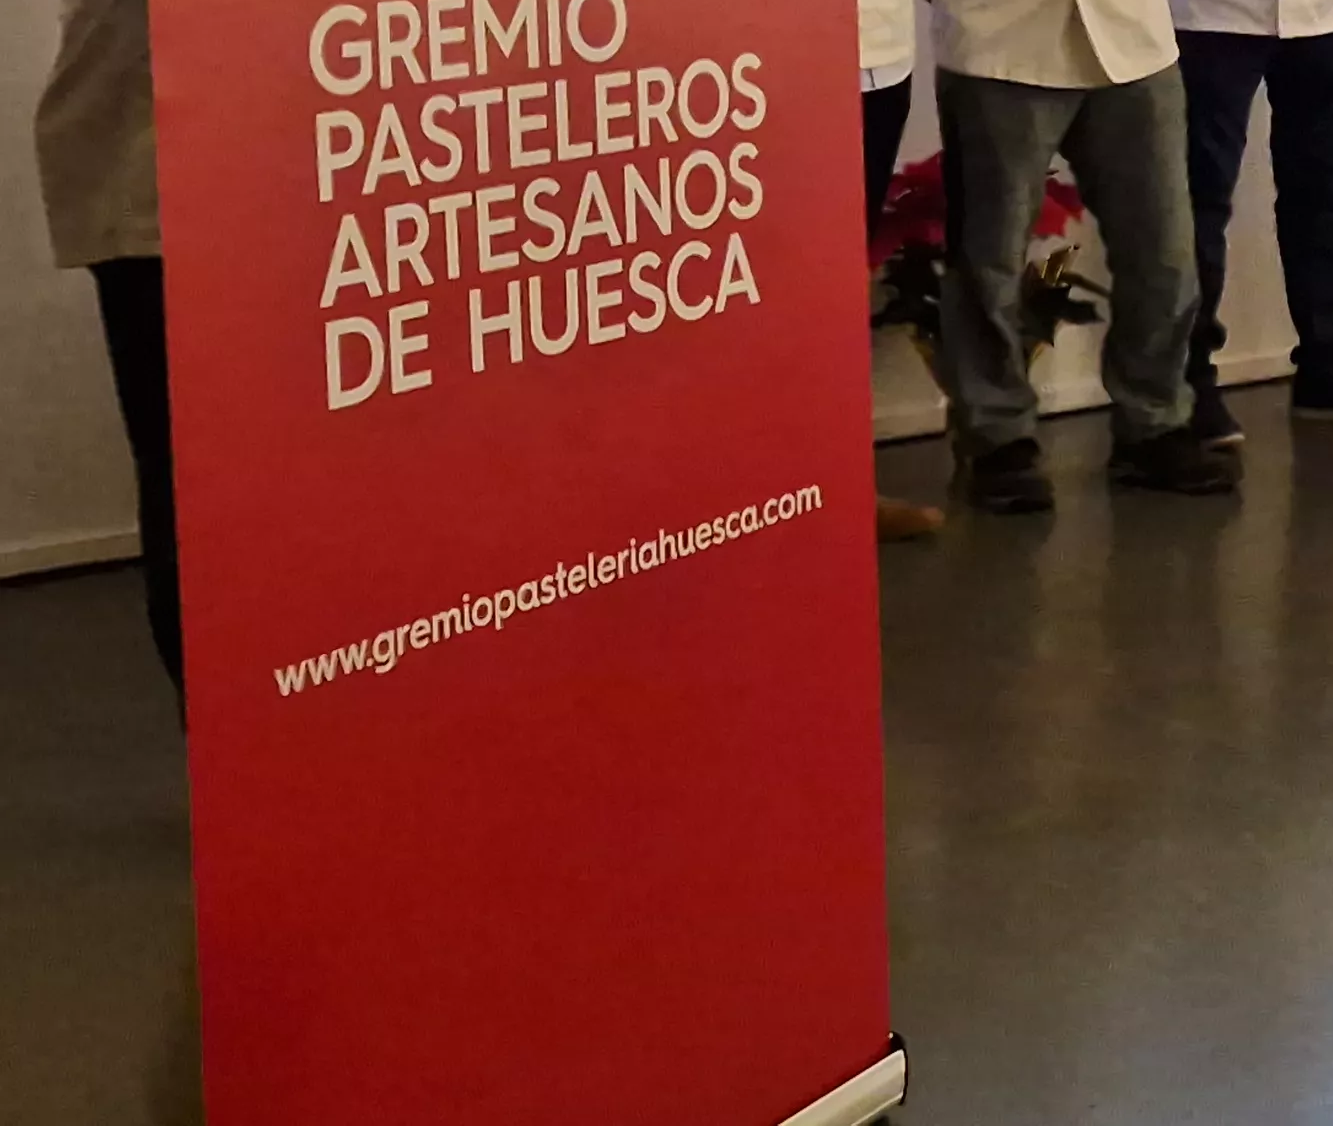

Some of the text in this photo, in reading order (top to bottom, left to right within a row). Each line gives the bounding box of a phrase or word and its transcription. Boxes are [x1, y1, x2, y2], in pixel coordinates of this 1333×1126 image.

[316, 52, 767, 202] PASTELEROS
[320, 142, 764, 308] ARTESANOS
[325, 232, 762, 411] DE HUESCA
[274, 483, 823, 696] www.gremiopasteleriahuesca.com
